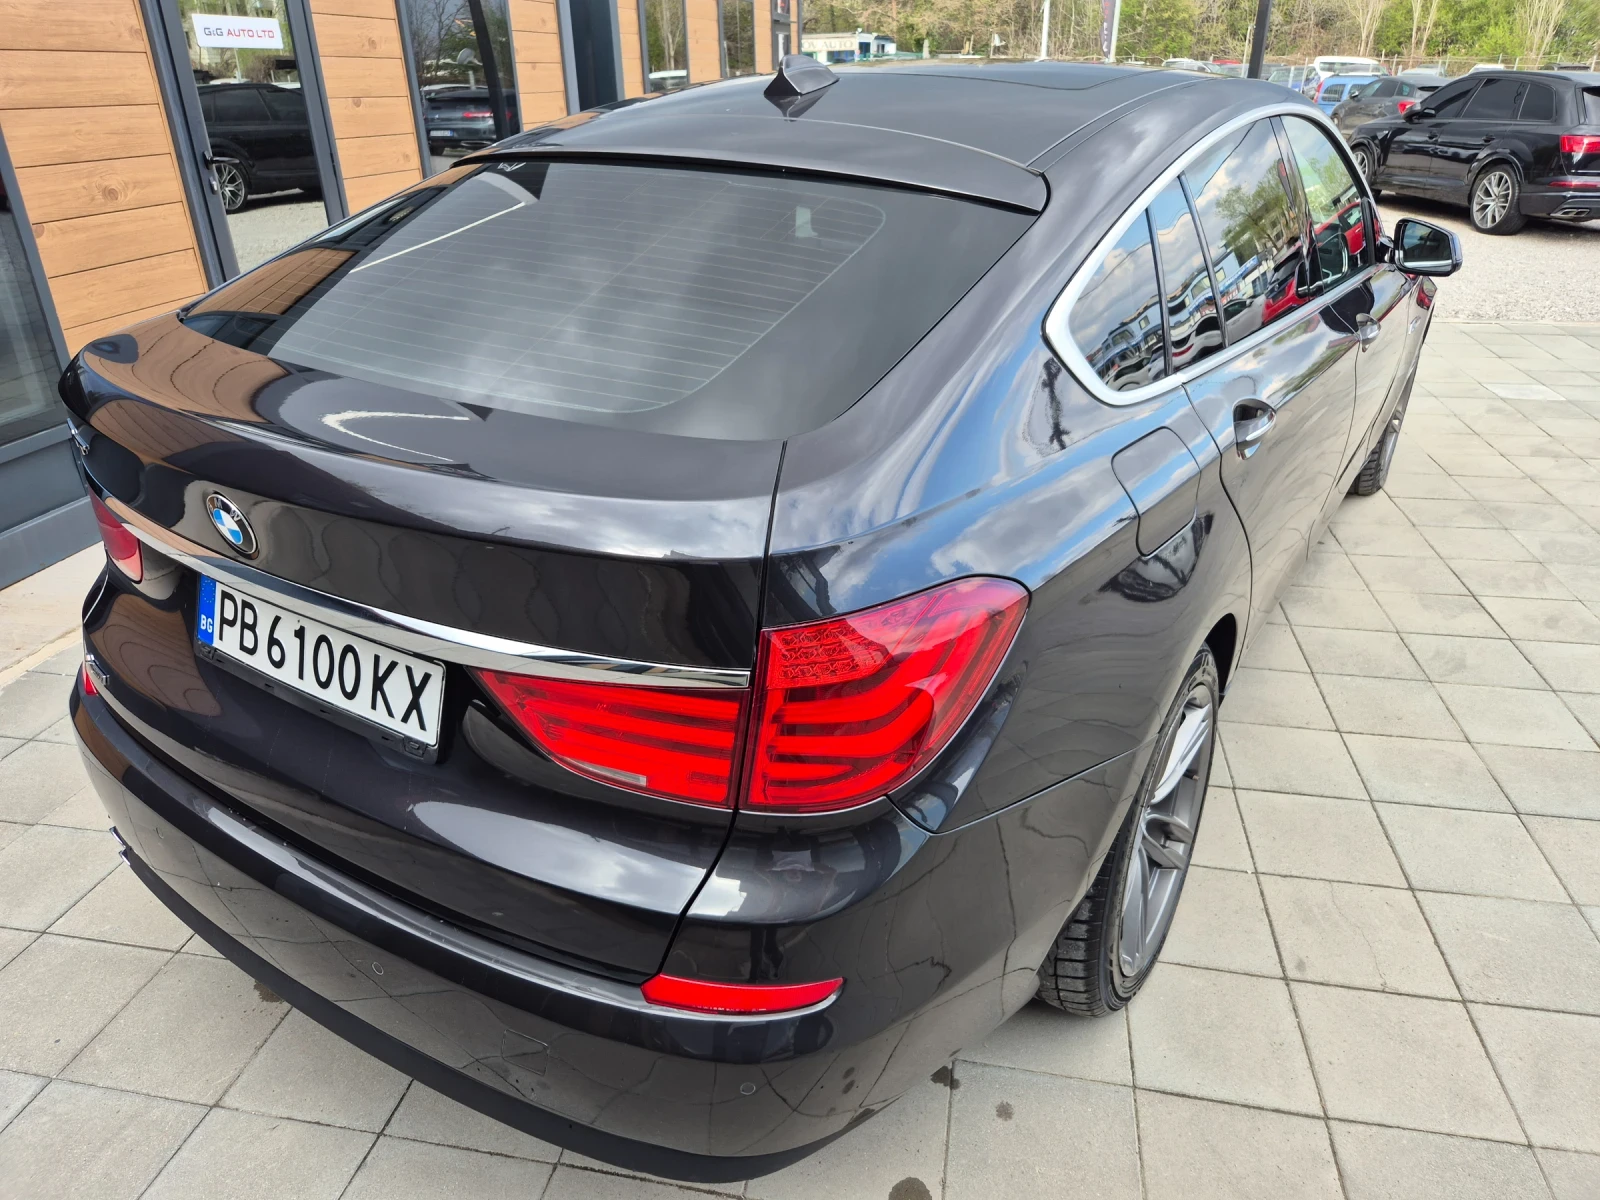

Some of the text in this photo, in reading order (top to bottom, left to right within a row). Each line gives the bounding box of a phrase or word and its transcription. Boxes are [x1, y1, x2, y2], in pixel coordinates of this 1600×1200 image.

[227, 28, 255, 38] AUTO
[256, 29, 275, 39] LTD
[823, 40, 853, 49] AUTO
[200, 614, 213, 634] BG
